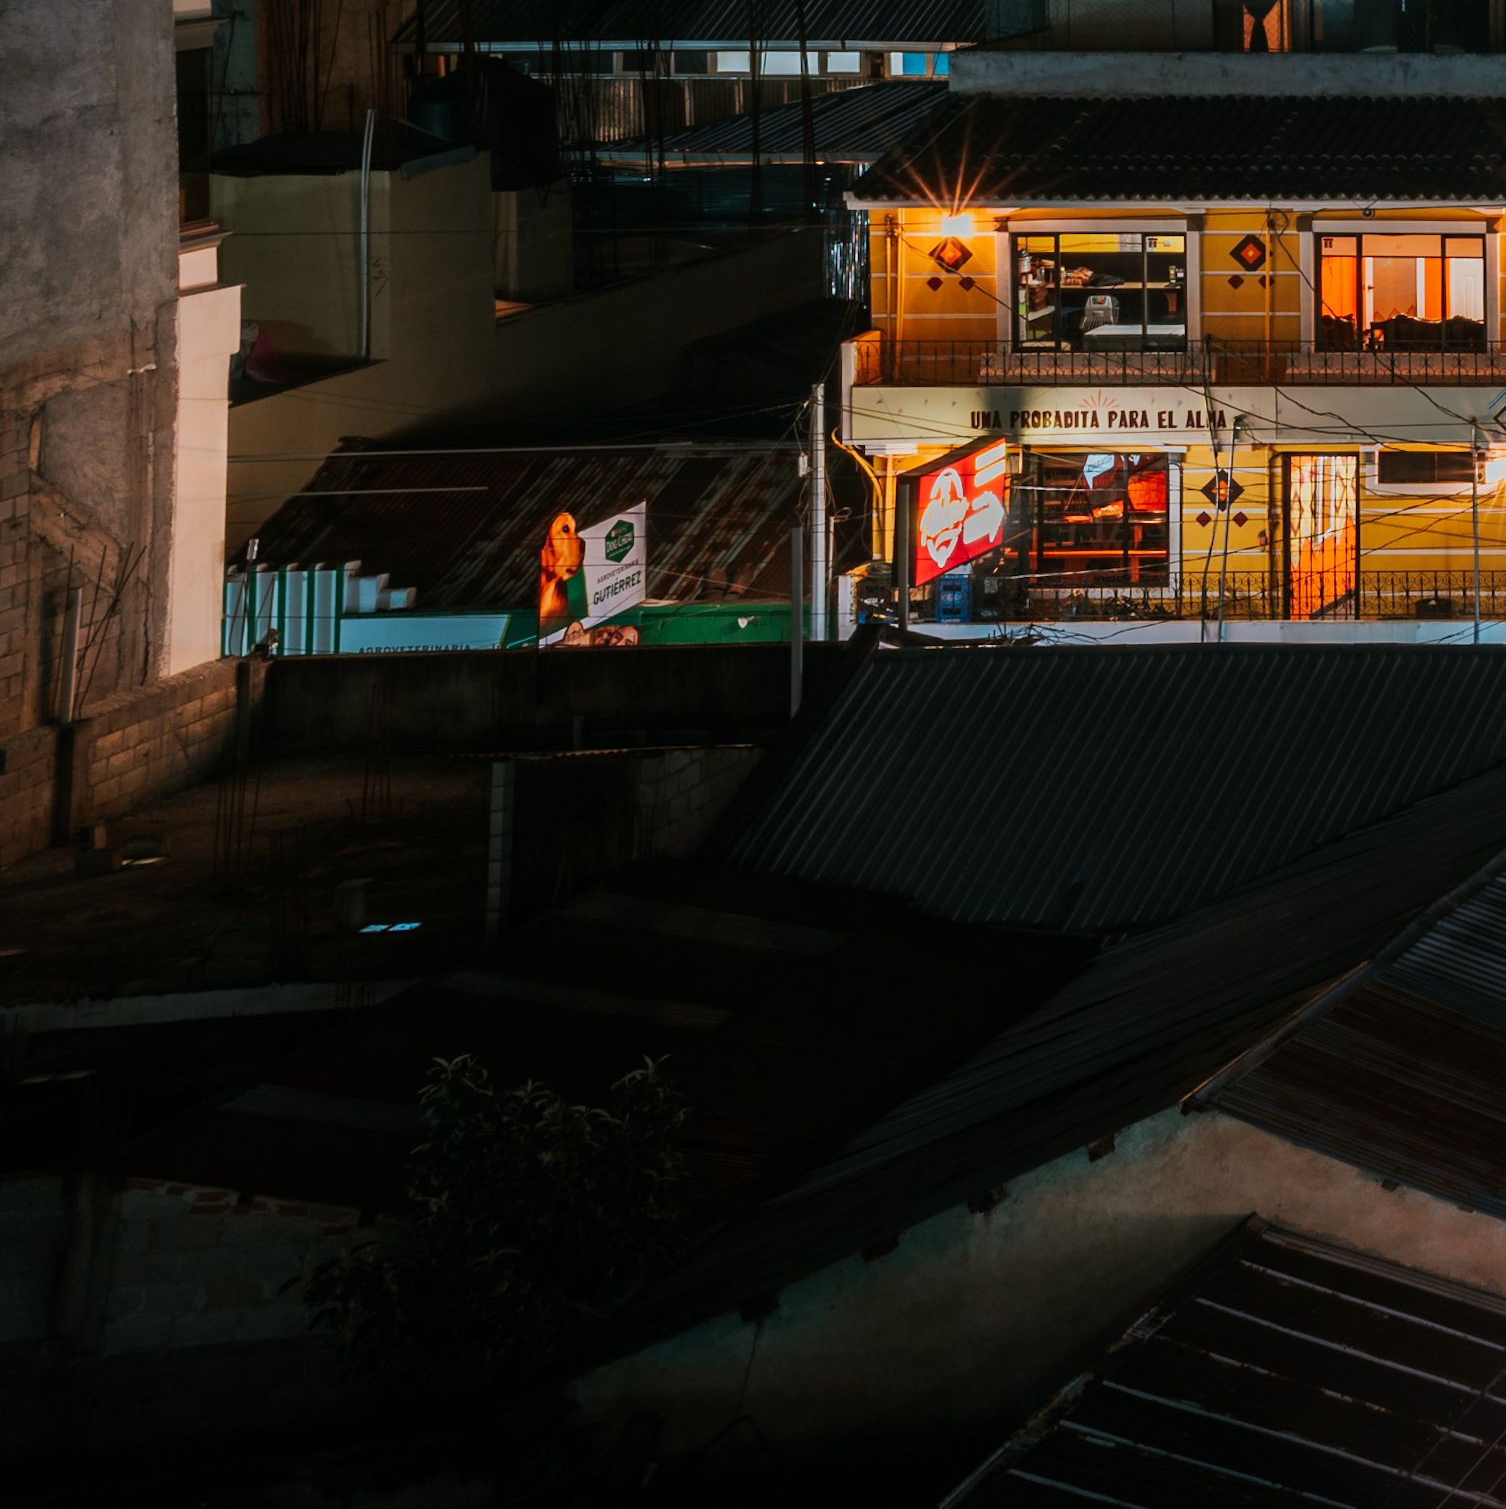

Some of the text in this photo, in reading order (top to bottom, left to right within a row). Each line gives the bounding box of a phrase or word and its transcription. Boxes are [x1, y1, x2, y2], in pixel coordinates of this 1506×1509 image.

[1010, 410, 1100, 429] PROBADITA
[1108, 410, 1149, 429] PARA
[1158, 410, 1178, 429] EL
